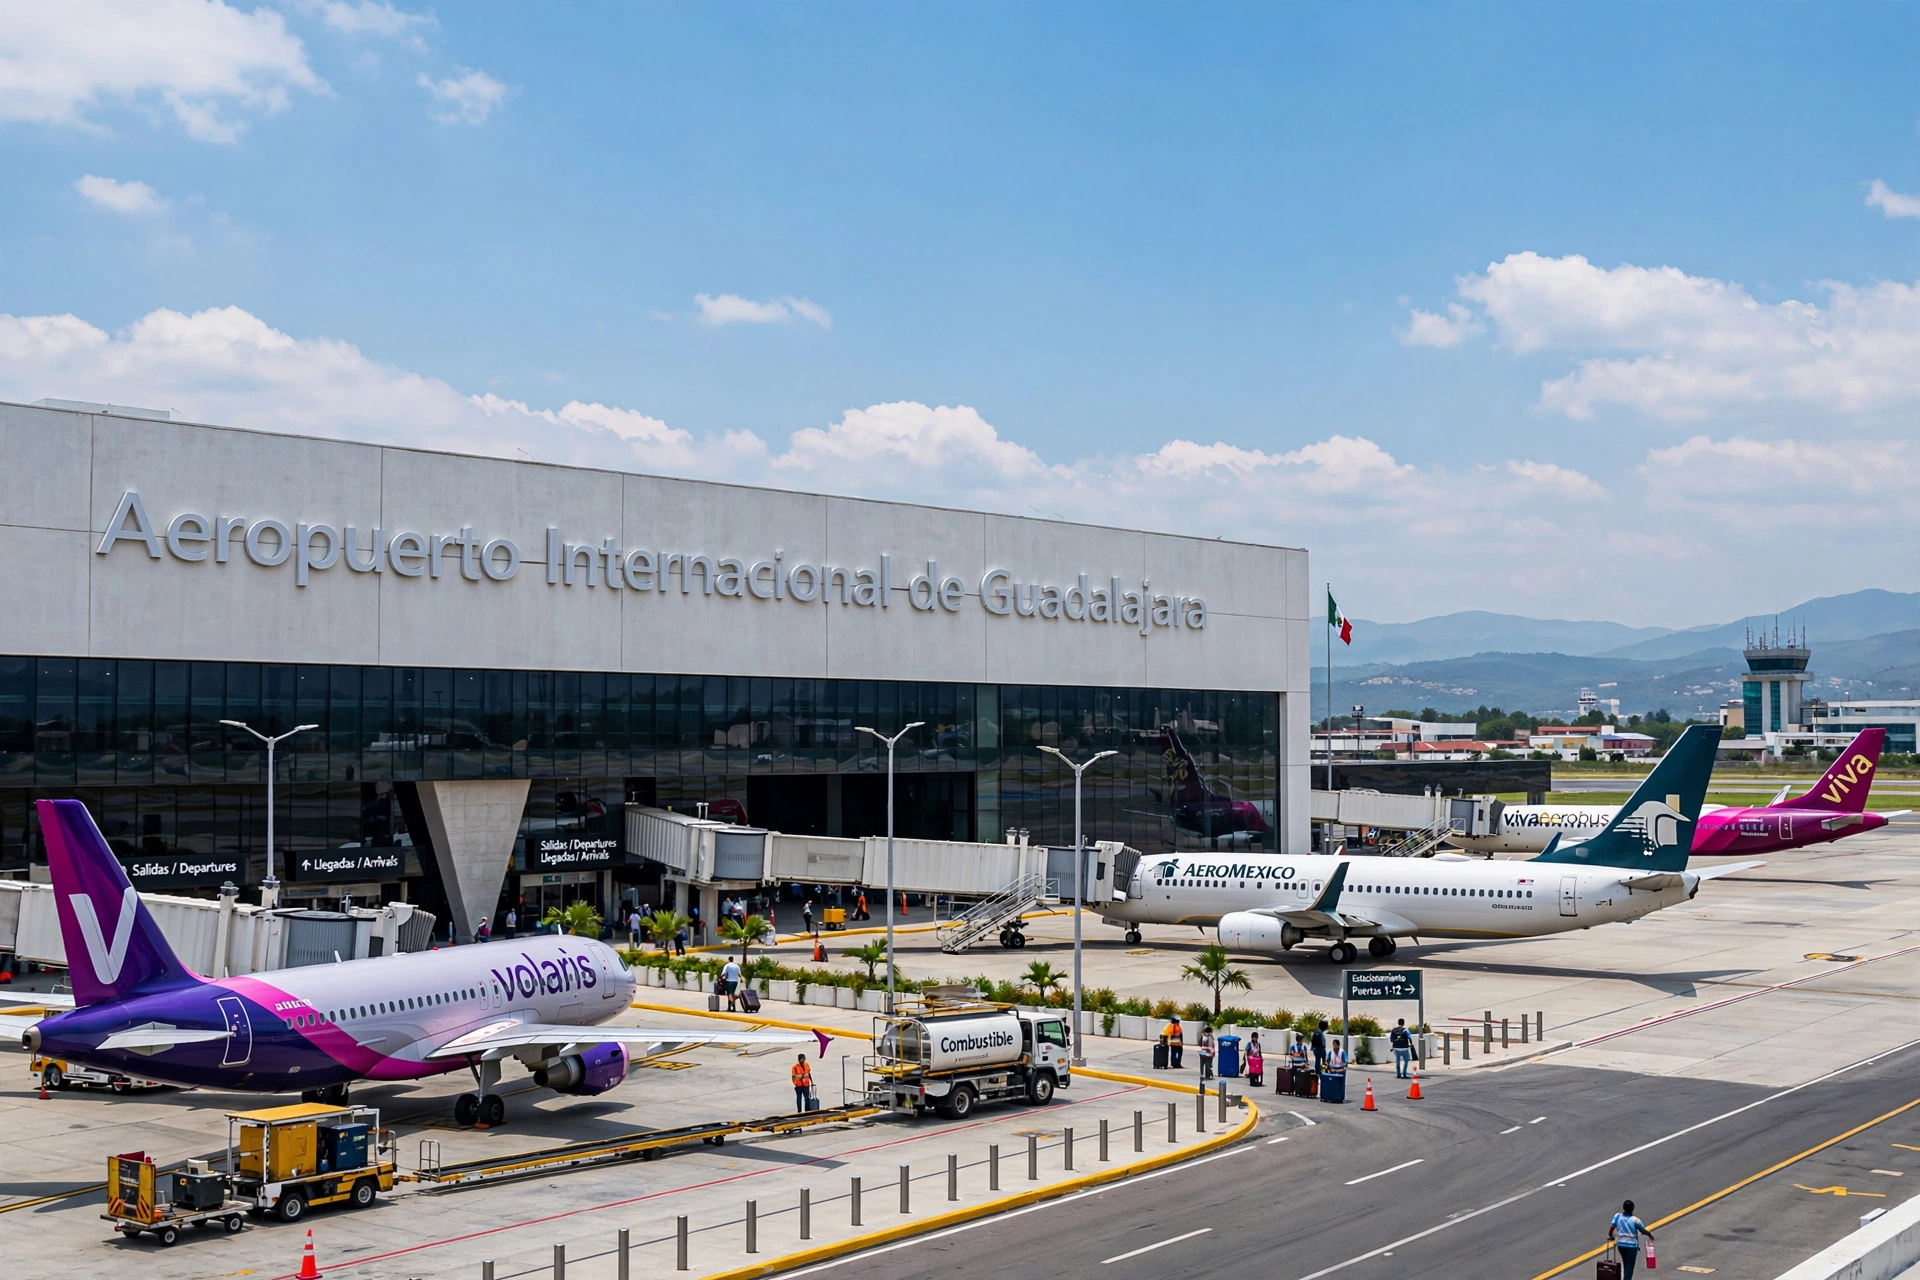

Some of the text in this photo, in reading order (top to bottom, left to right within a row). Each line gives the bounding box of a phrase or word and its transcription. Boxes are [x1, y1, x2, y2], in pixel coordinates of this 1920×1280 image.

[96, 490, 1208, 636] Aeropuerto Internacional de Guadalajara
[1821, 753, 1873, 804] viva
[540, 840, 568, 851] Salidas
[574, 839, 617, 852] Departures
[314, 855, 398, 873] Llegadas / Arrivals
[540, 851, 575, 865] Llegadas
[581, 849, 610, 861] Arrivals
[132, 862, 237, 876] Salidas / Departures
[491, 948, 597, 1001] volaris
[1352, 985, 1402, 996] Puertas 1-12
[941, 1031, 1014, 1053] Combustible
